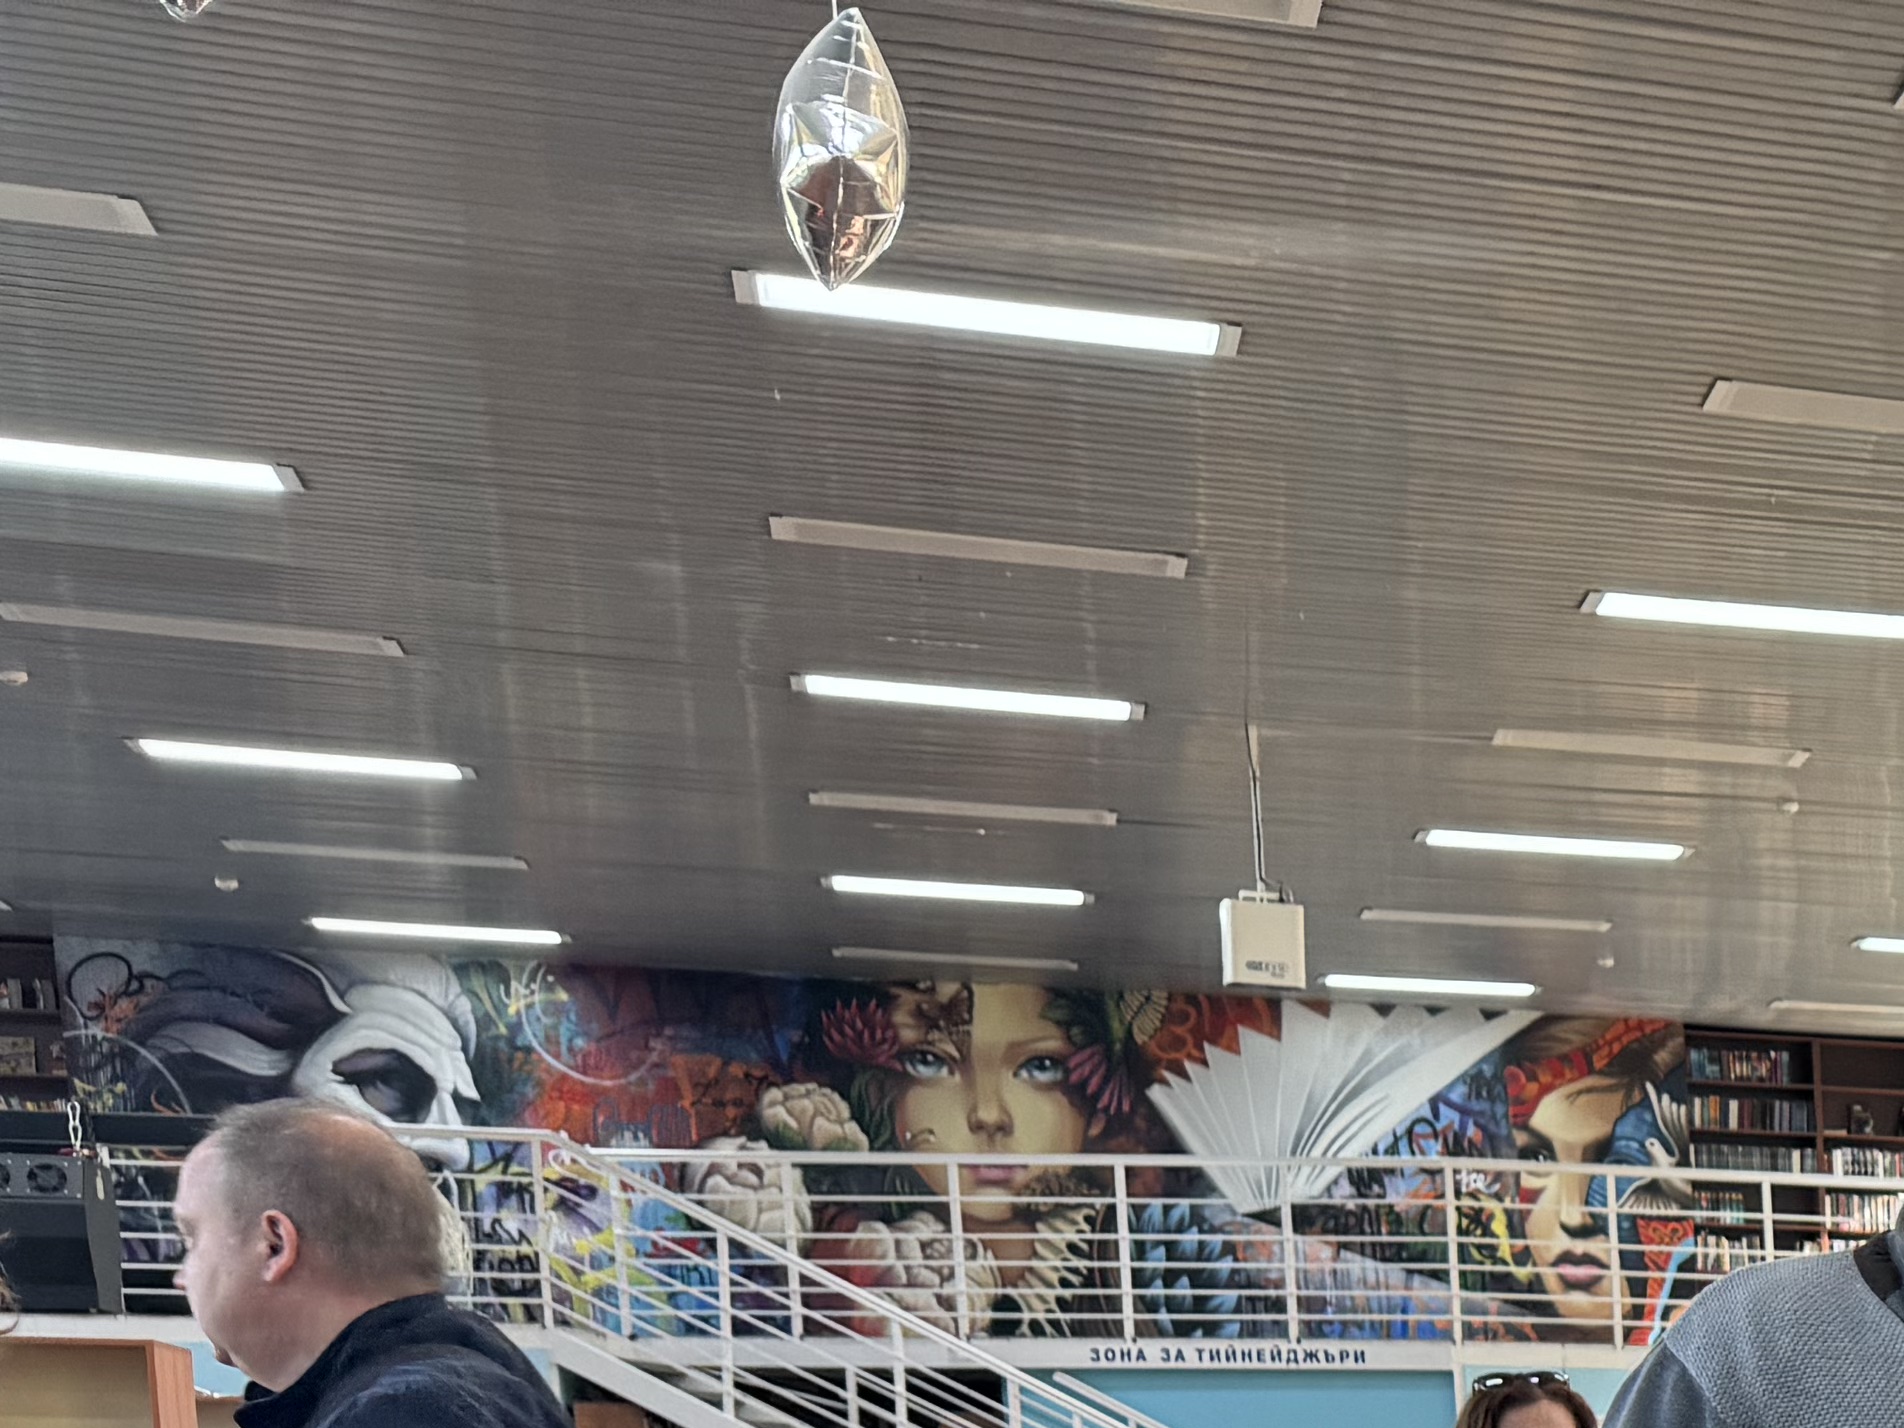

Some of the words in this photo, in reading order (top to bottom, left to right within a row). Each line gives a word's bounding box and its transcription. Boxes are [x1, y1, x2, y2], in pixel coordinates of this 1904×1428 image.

[1089, 1347, 1147, 1363] ЗОНА
[1160, 1347, 1186, 1363] ЗА
[1195, 1344, 1367, 1366] ТИЙНЕЙДЖЪРИ
